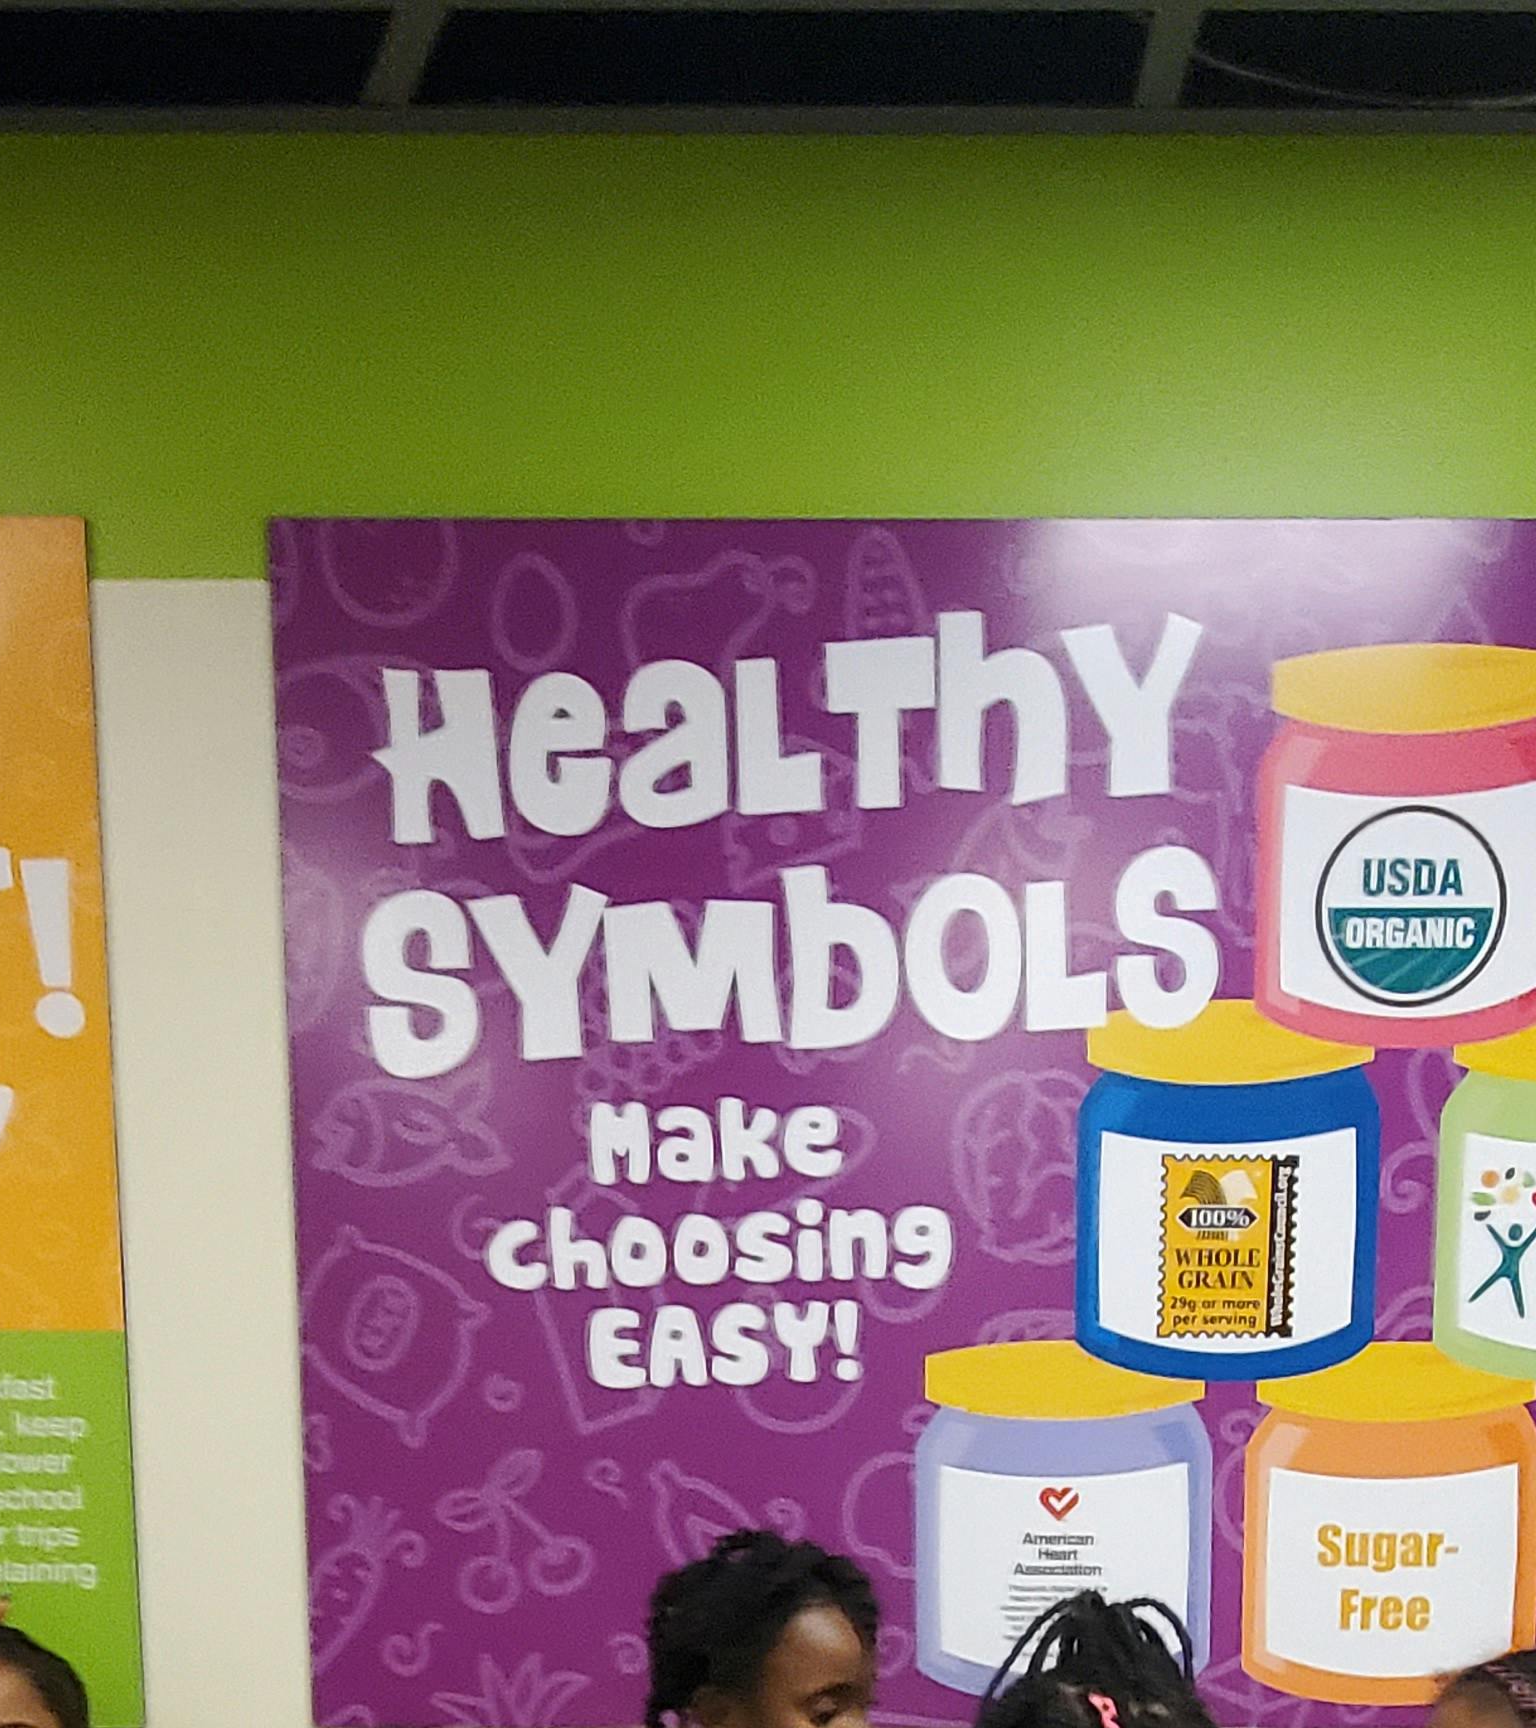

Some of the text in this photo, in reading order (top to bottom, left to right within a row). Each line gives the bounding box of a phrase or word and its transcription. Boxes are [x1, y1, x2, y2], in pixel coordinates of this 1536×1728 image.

[1363, 858, 1464, 897] USDA
[1345, 917, 1476, 949] ORGANIC
[589, 1097, 843, 1186] Make
[1190, 1208, 1251, 1228] 100%
[1175, 1248, 1261, 1268] WHOLE
[1177, 1270, 1255, 1290] GRAIN
[1222, 1299, 1261, 1311] more
[1172, 1314, 1258, 1329] per serving
[587, 1300, 860, 1389] EASY!
[14, 1411, 86, 1441] keep
[16, 1523, 80, 1551] trips
[1022, 1532, 1095, 1546] American
[1317, 1523, 1459, 1572] Sugar-
[1037, 1547, 1078, 1560] Heart
[1013, 1562, 1103, 1576] Association
[1339, 1588, 1432, 1632] Free
